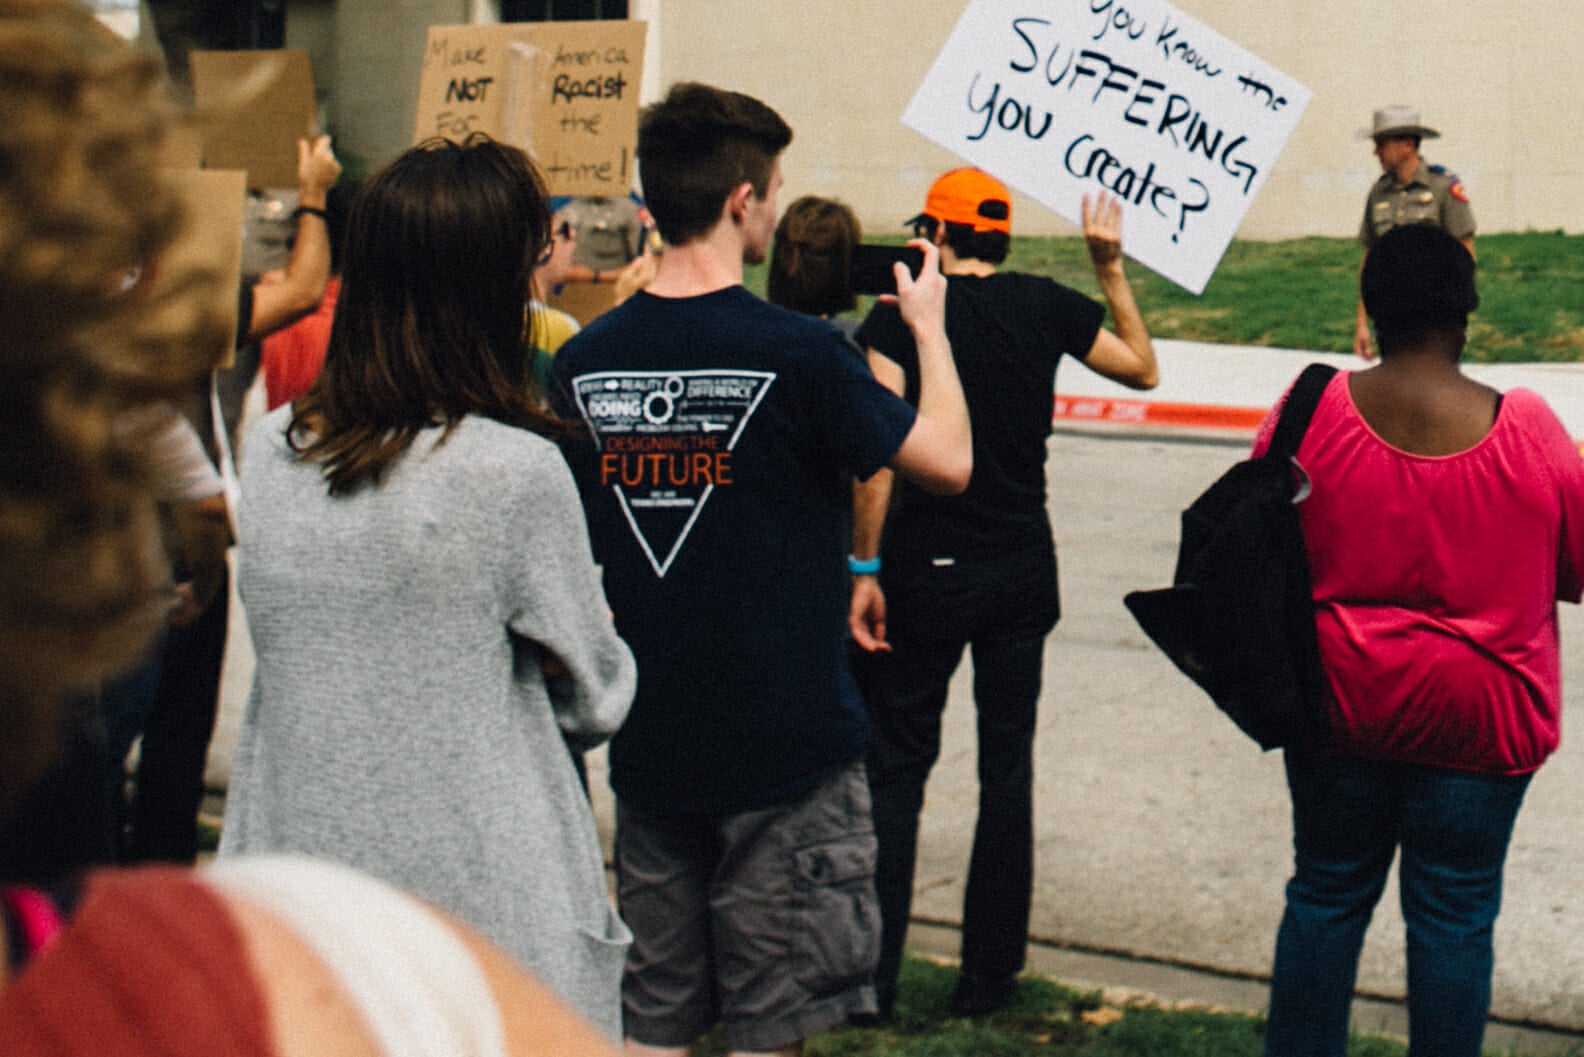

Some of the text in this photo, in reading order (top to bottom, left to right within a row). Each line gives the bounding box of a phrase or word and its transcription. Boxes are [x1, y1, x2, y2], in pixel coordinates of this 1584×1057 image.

[444, 72, 628, 105] NOT Racist
[1009, 17, 1258, 196] SUFFERING
[605, 434, 719, 452] DESIGNING THE
[600, 452, 735, 486] FUTURE
